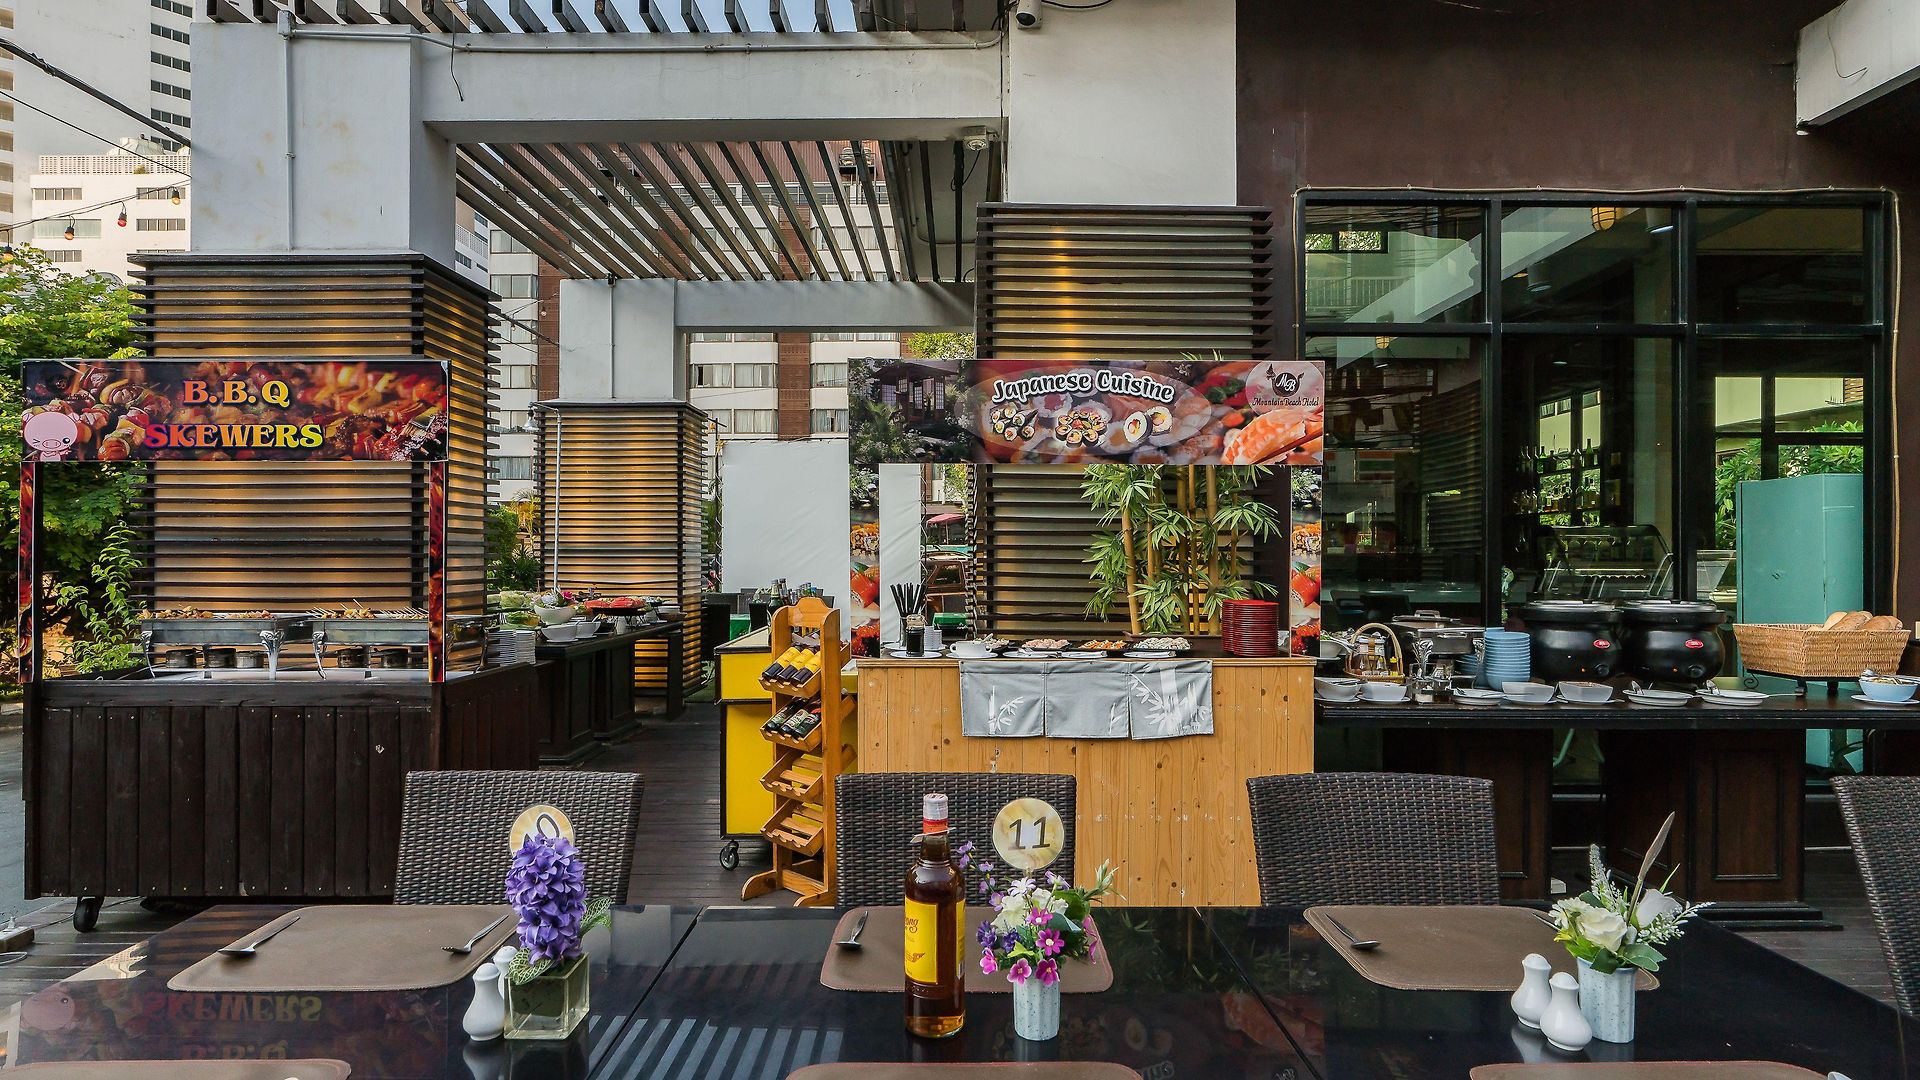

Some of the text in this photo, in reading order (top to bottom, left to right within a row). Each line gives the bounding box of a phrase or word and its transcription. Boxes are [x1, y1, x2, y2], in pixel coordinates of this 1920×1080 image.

[992, 369, 1176, 403] Japanese Cuisine
[1302, 396, 1319, 407] Hotel
[144, 424, 324, 448] SKEWERS
[1009, 816, 1051, 850] 11
